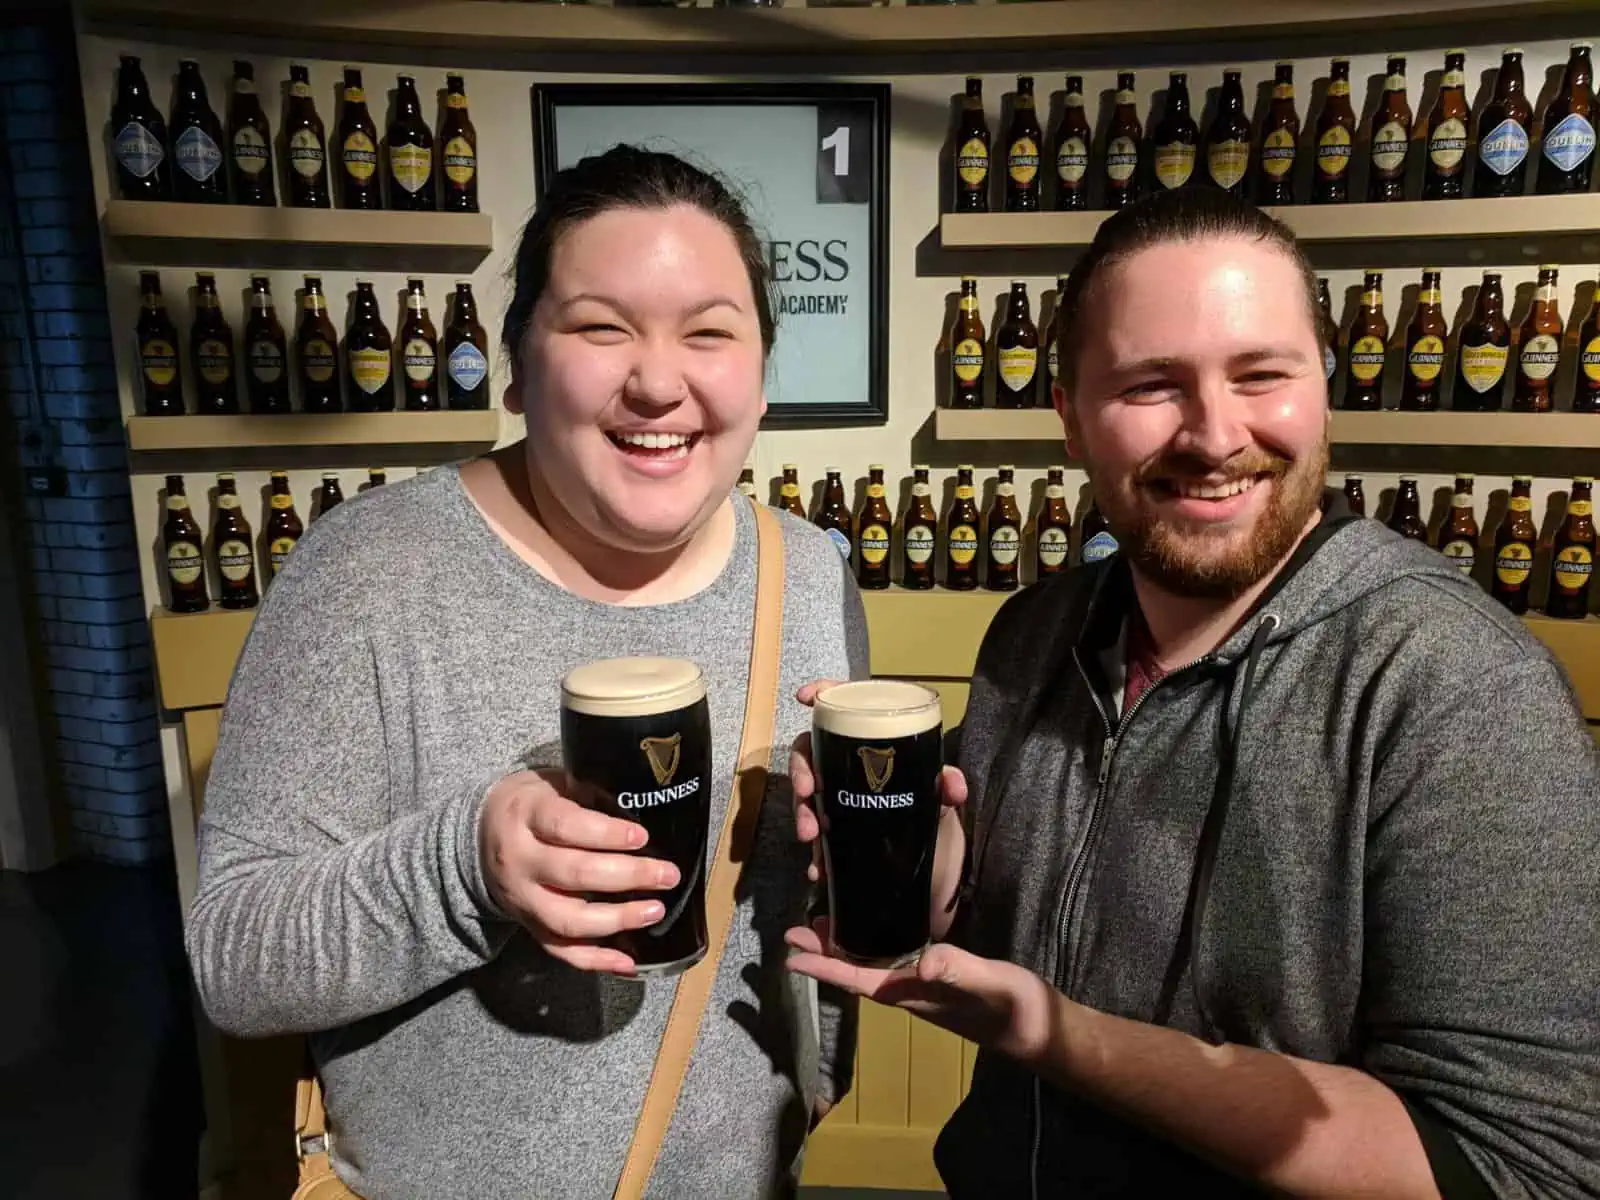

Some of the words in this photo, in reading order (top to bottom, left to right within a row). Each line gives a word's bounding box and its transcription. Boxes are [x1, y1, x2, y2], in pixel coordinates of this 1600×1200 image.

[822, 126, 850, 176] 1
[769, 239, 848, 282] ESS
[781, 296, 848, 315] ACADEMY
[1521, 353, 1559, 364] GUINNESS
[617, 776, 700, 809] GUINNESS
[837, 790, 915, 809] GUINNESS
